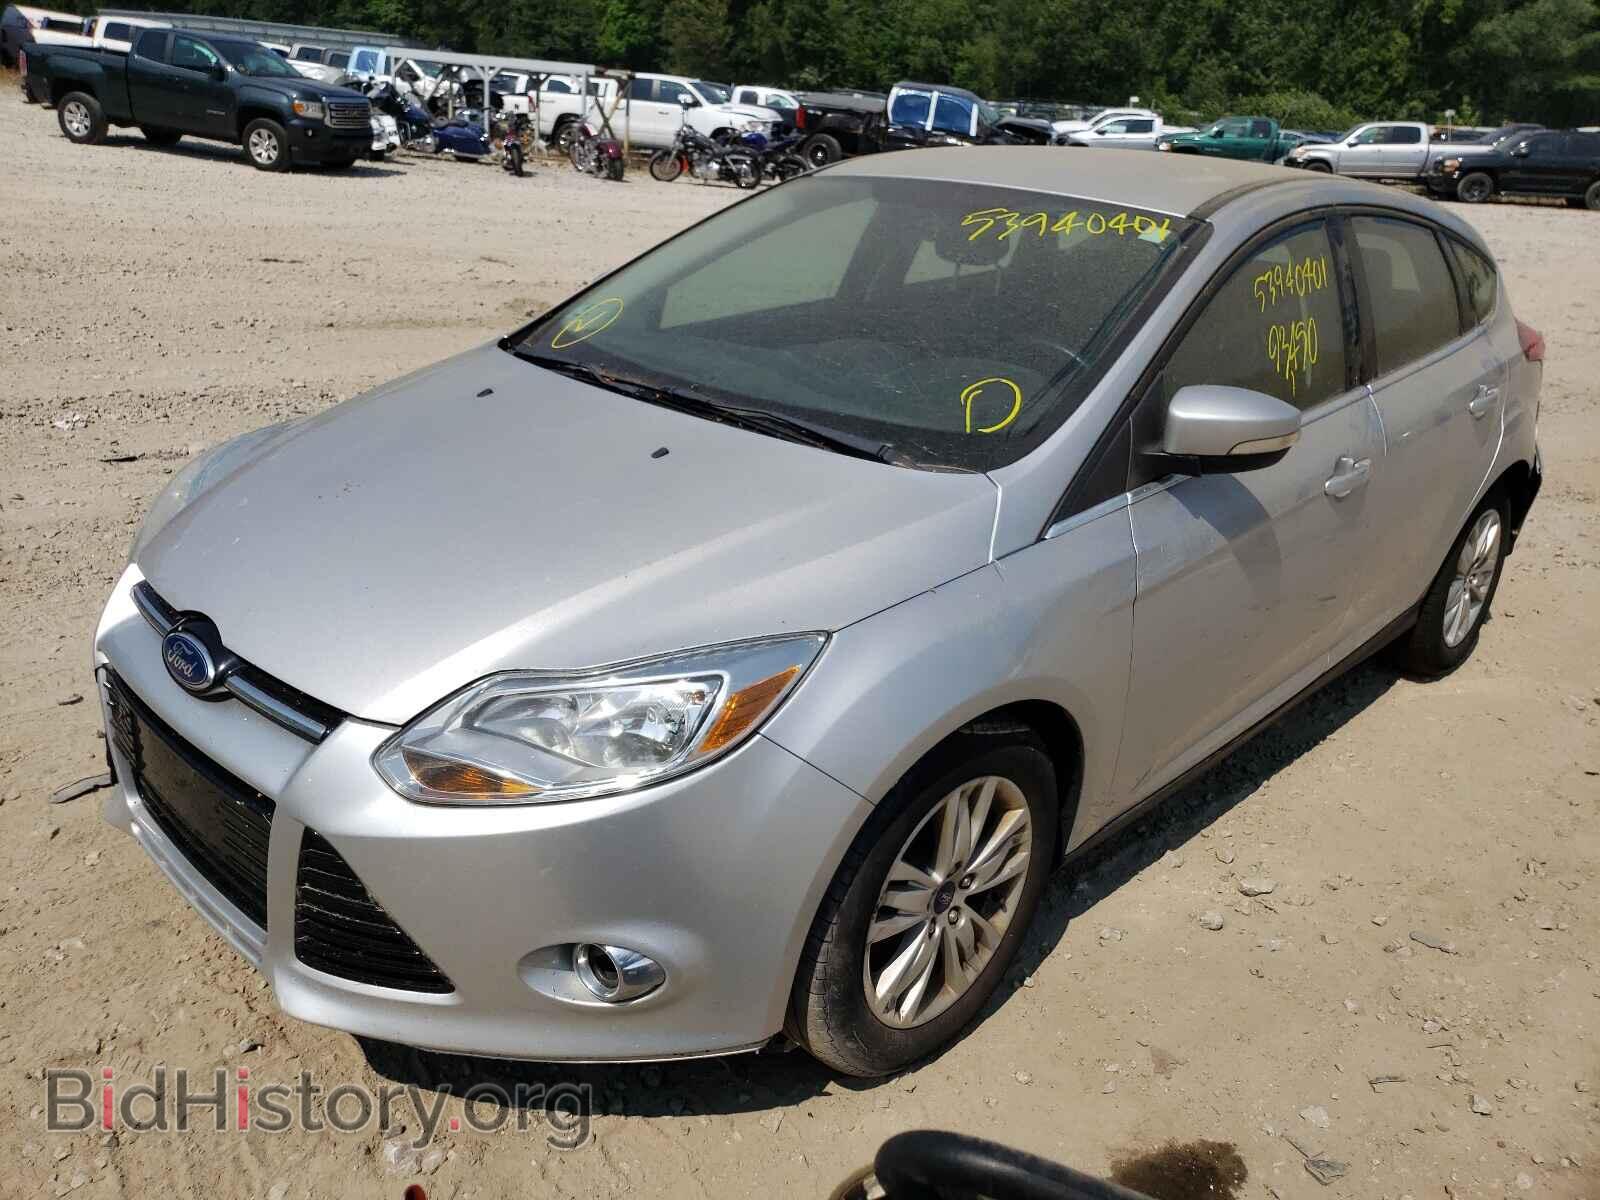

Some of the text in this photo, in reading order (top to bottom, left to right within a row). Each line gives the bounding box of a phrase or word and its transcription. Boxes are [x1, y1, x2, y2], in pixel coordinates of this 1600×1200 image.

[961, 208, 1170, 241] 53940401
[1255, 256, 1328, 312] 53940401
[168, 642, 198, 677] Ford
